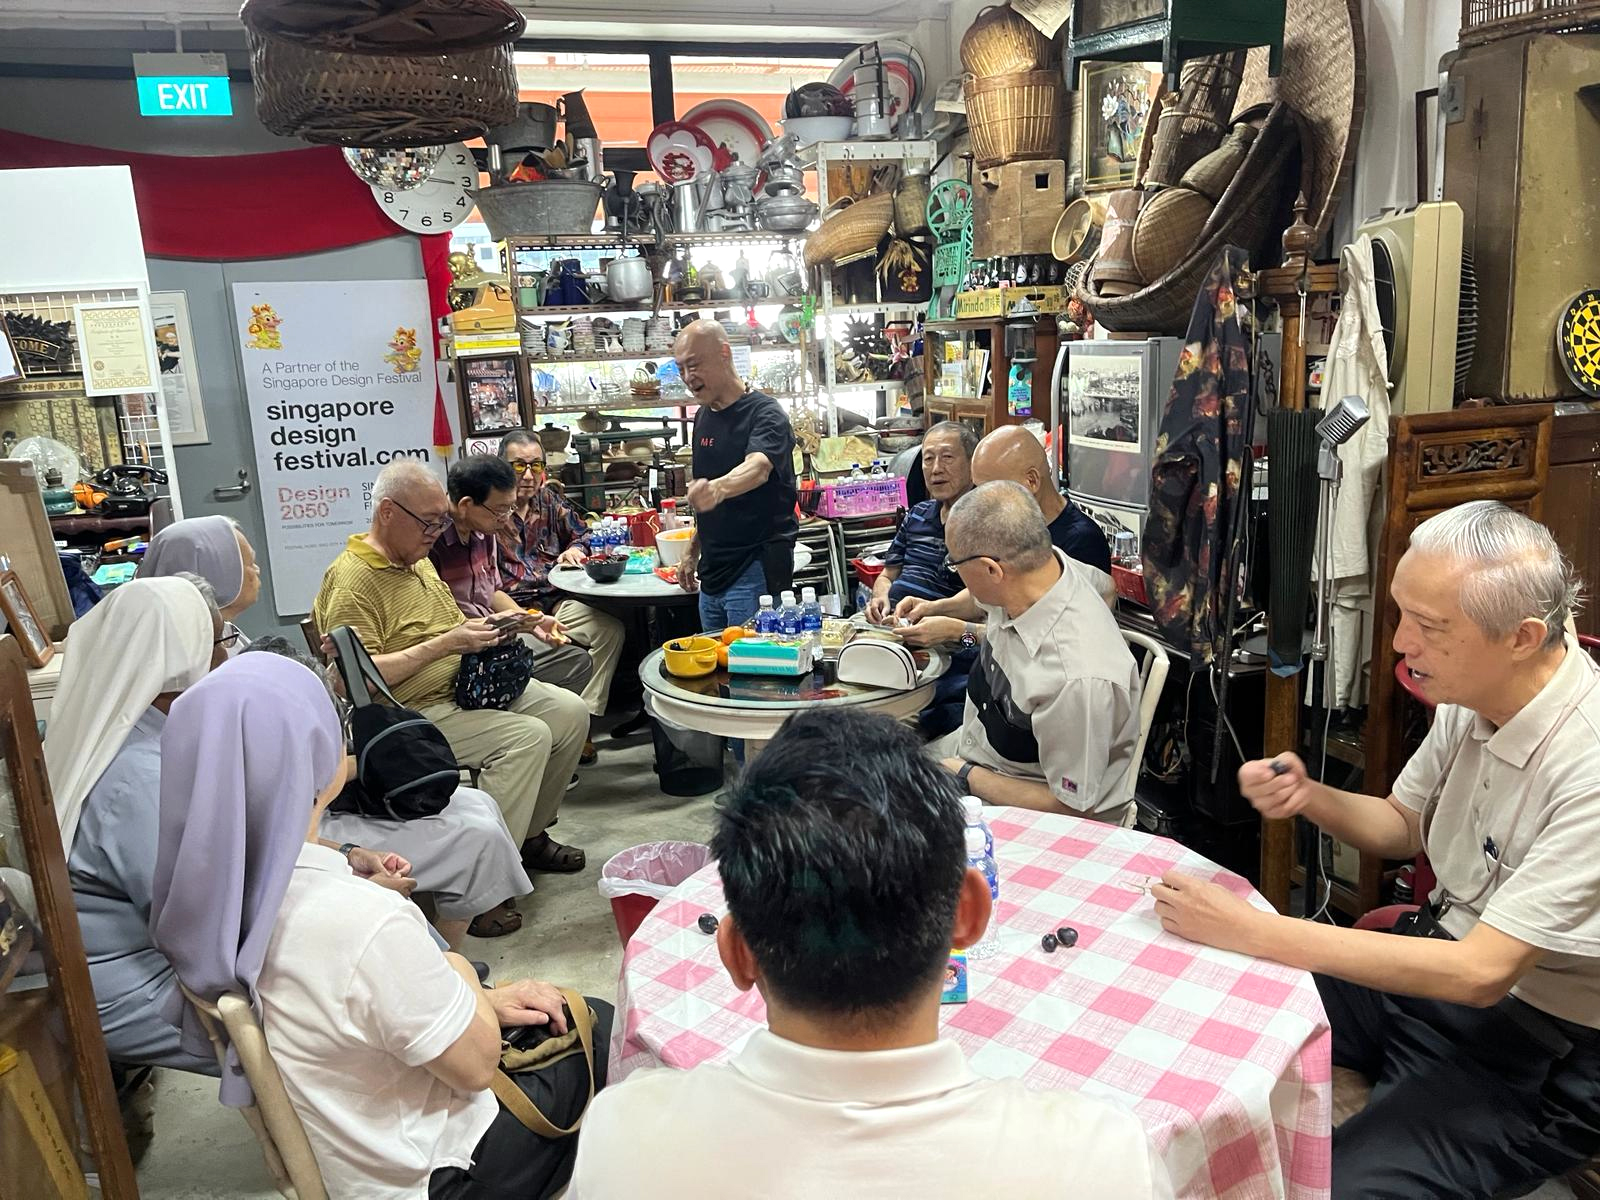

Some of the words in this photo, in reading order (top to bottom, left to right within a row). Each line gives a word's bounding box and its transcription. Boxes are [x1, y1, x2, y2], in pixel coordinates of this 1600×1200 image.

[157, 83, 209, 110] EXIT
[456, 154, 466, 165] 2
[461, 176, 472, 188] 3
[384, 192, 394, 204] 8
[456, 196, 466, 207] 4
[399, 209, 409, 221] 7
[421, 216, 432, 227] 6
[443, 212, 453, 223] 5
[262, 362, 272, 374] A
[275, 362, 321, 374] Partner
[324, 361, 337, 373] of
[340, 360, 359, 372] the
[263, 376, 328, 390] Singapore
[332, 374, 373, 387] Design
[377, 371, 422, 384] Festival
[266, 400, 394, 423] singapore
[270, 424, 356, 447] design
[278, 485, 351, 503] Design
[280, 502, 330, 521] 2050
